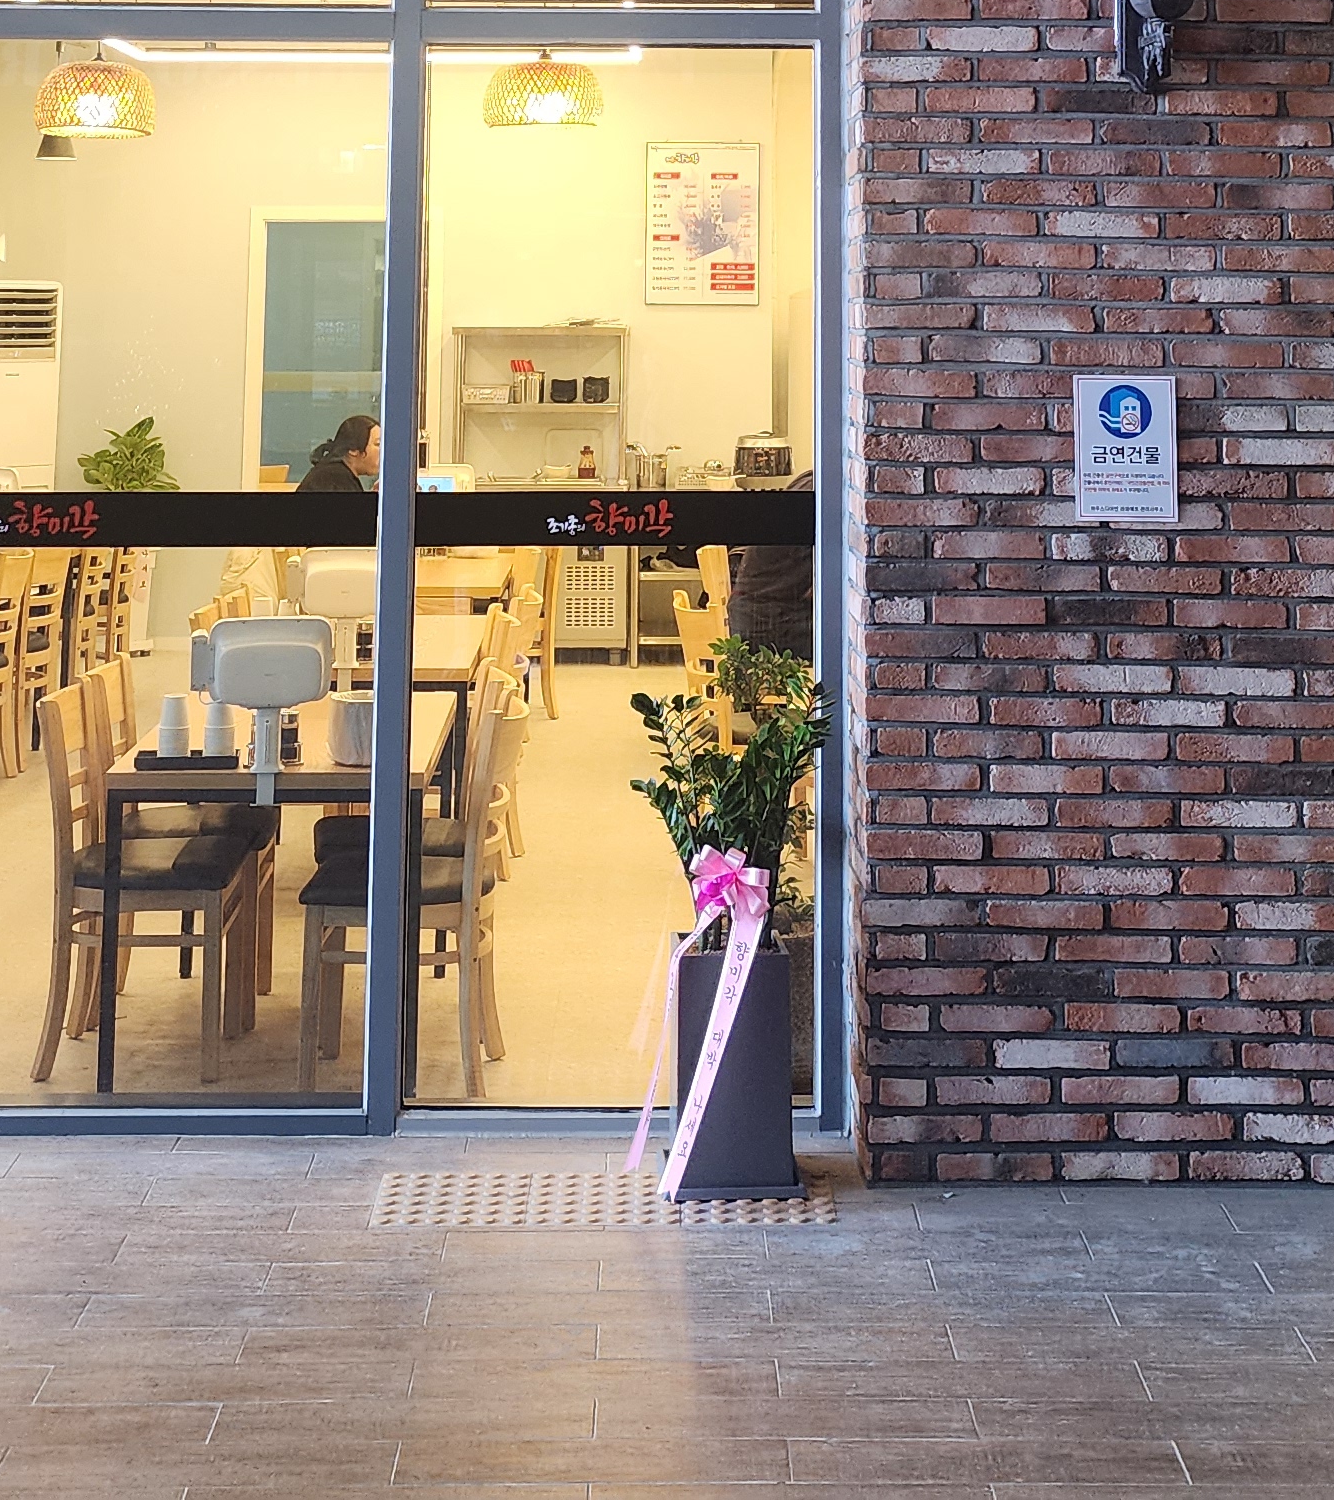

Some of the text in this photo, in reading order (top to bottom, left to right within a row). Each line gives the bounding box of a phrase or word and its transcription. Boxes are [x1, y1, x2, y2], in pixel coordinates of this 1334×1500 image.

[1090, 445, 1161, 465] 금연건물
[8, 499, 99, 539] 향미각
[584, 499, 674, 538] 향미각
